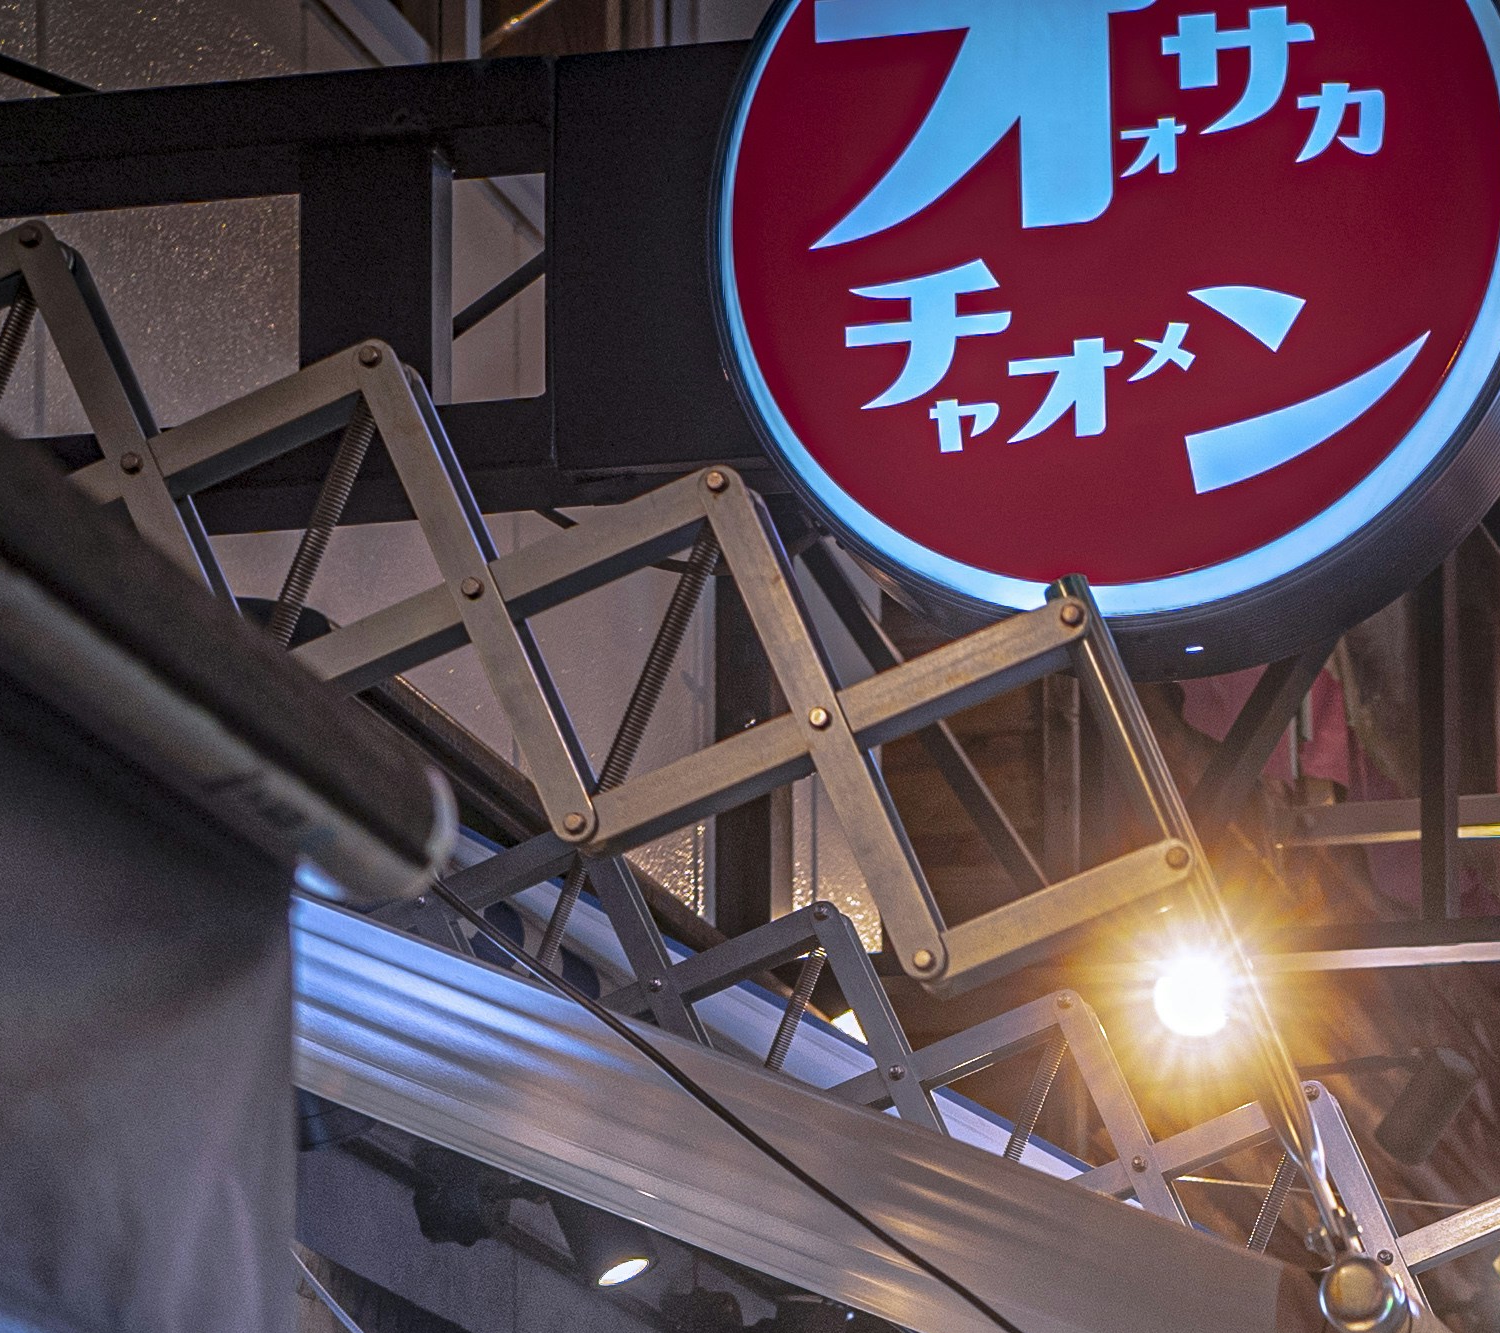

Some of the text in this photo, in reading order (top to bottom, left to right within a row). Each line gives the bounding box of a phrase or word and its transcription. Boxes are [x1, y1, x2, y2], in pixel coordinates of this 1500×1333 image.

[845, 258, 1431, 495] チャオメン
